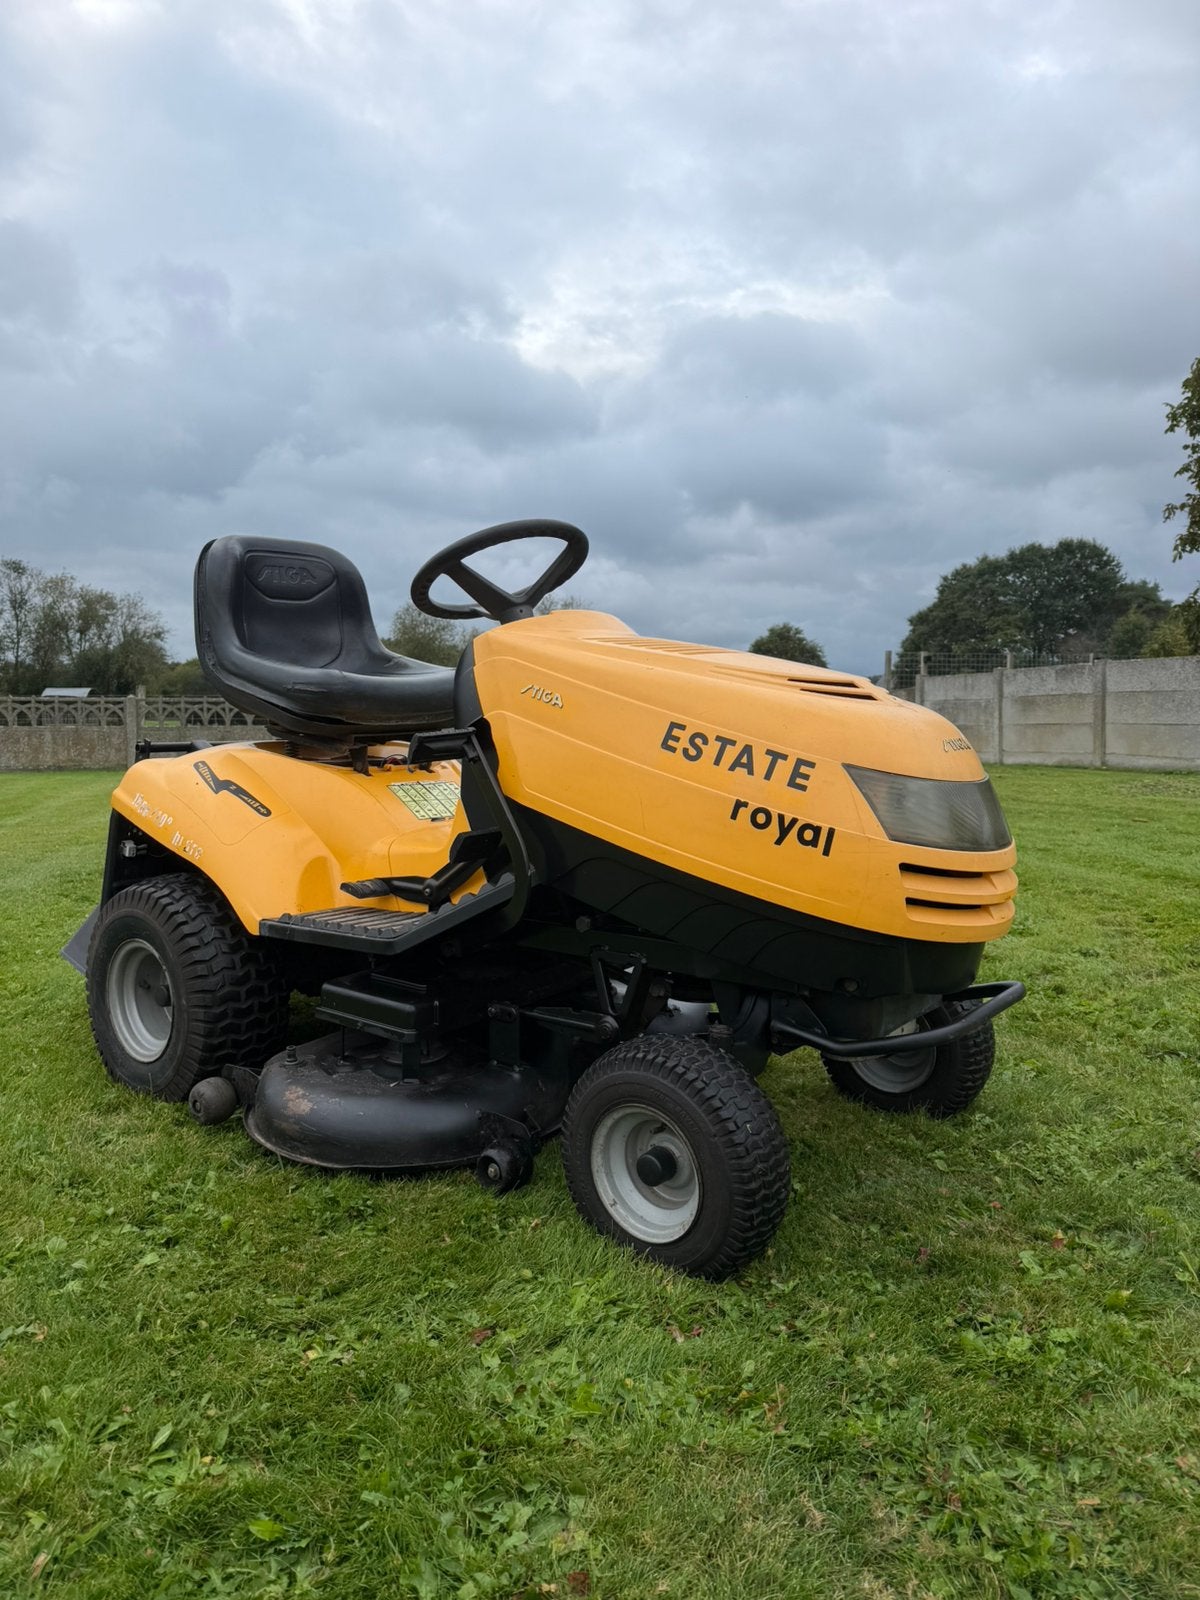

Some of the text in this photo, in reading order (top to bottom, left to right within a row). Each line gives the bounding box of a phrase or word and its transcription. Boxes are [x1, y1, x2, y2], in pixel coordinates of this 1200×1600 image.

[257, 565, 318, 585] STIGA
[520, 684, 564, 709] STIGA
[660, 721, 817, 792] ESTATE
[730, 798, 836, 857] royal
